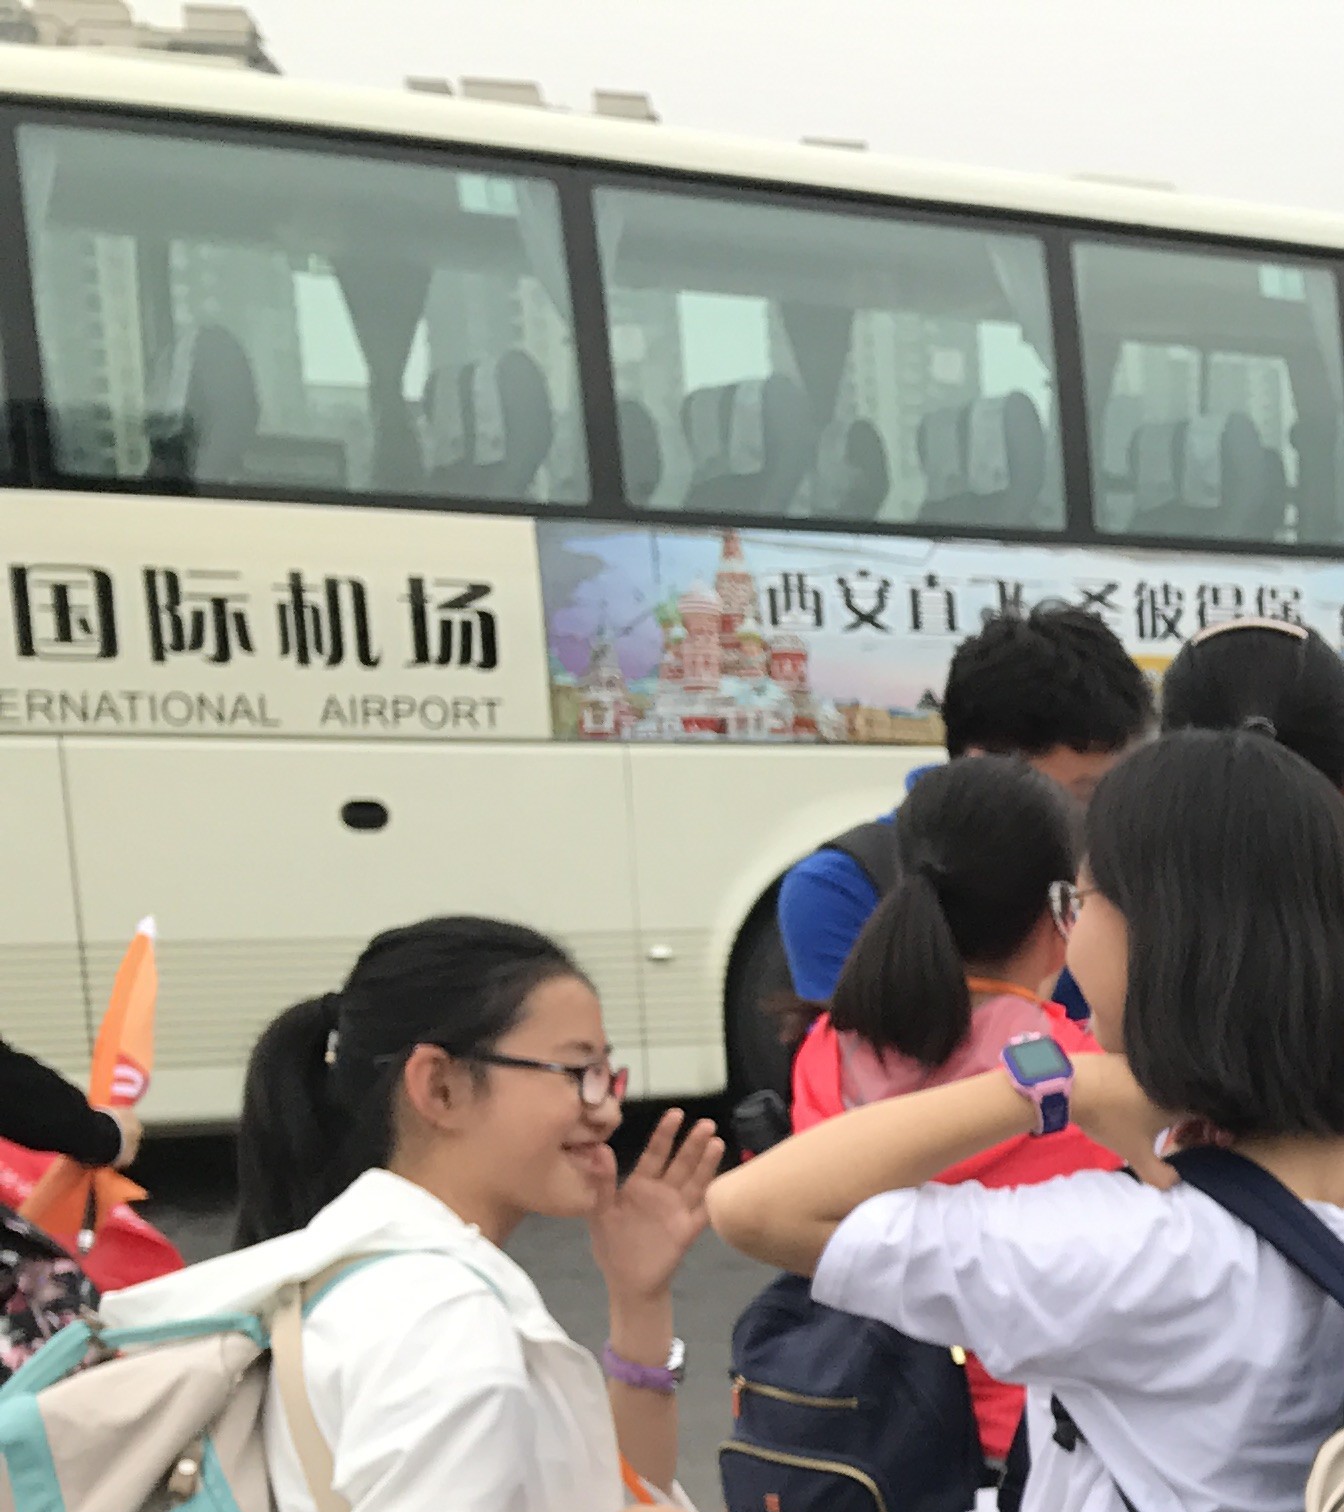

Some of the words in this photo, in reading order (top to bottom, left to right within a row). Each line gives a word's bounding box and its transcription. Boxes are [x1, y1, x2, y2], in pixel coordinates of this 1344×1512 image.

[8, 561, 499, 667] 国际机场
[320, 692, 503, 732] AIRPORT
